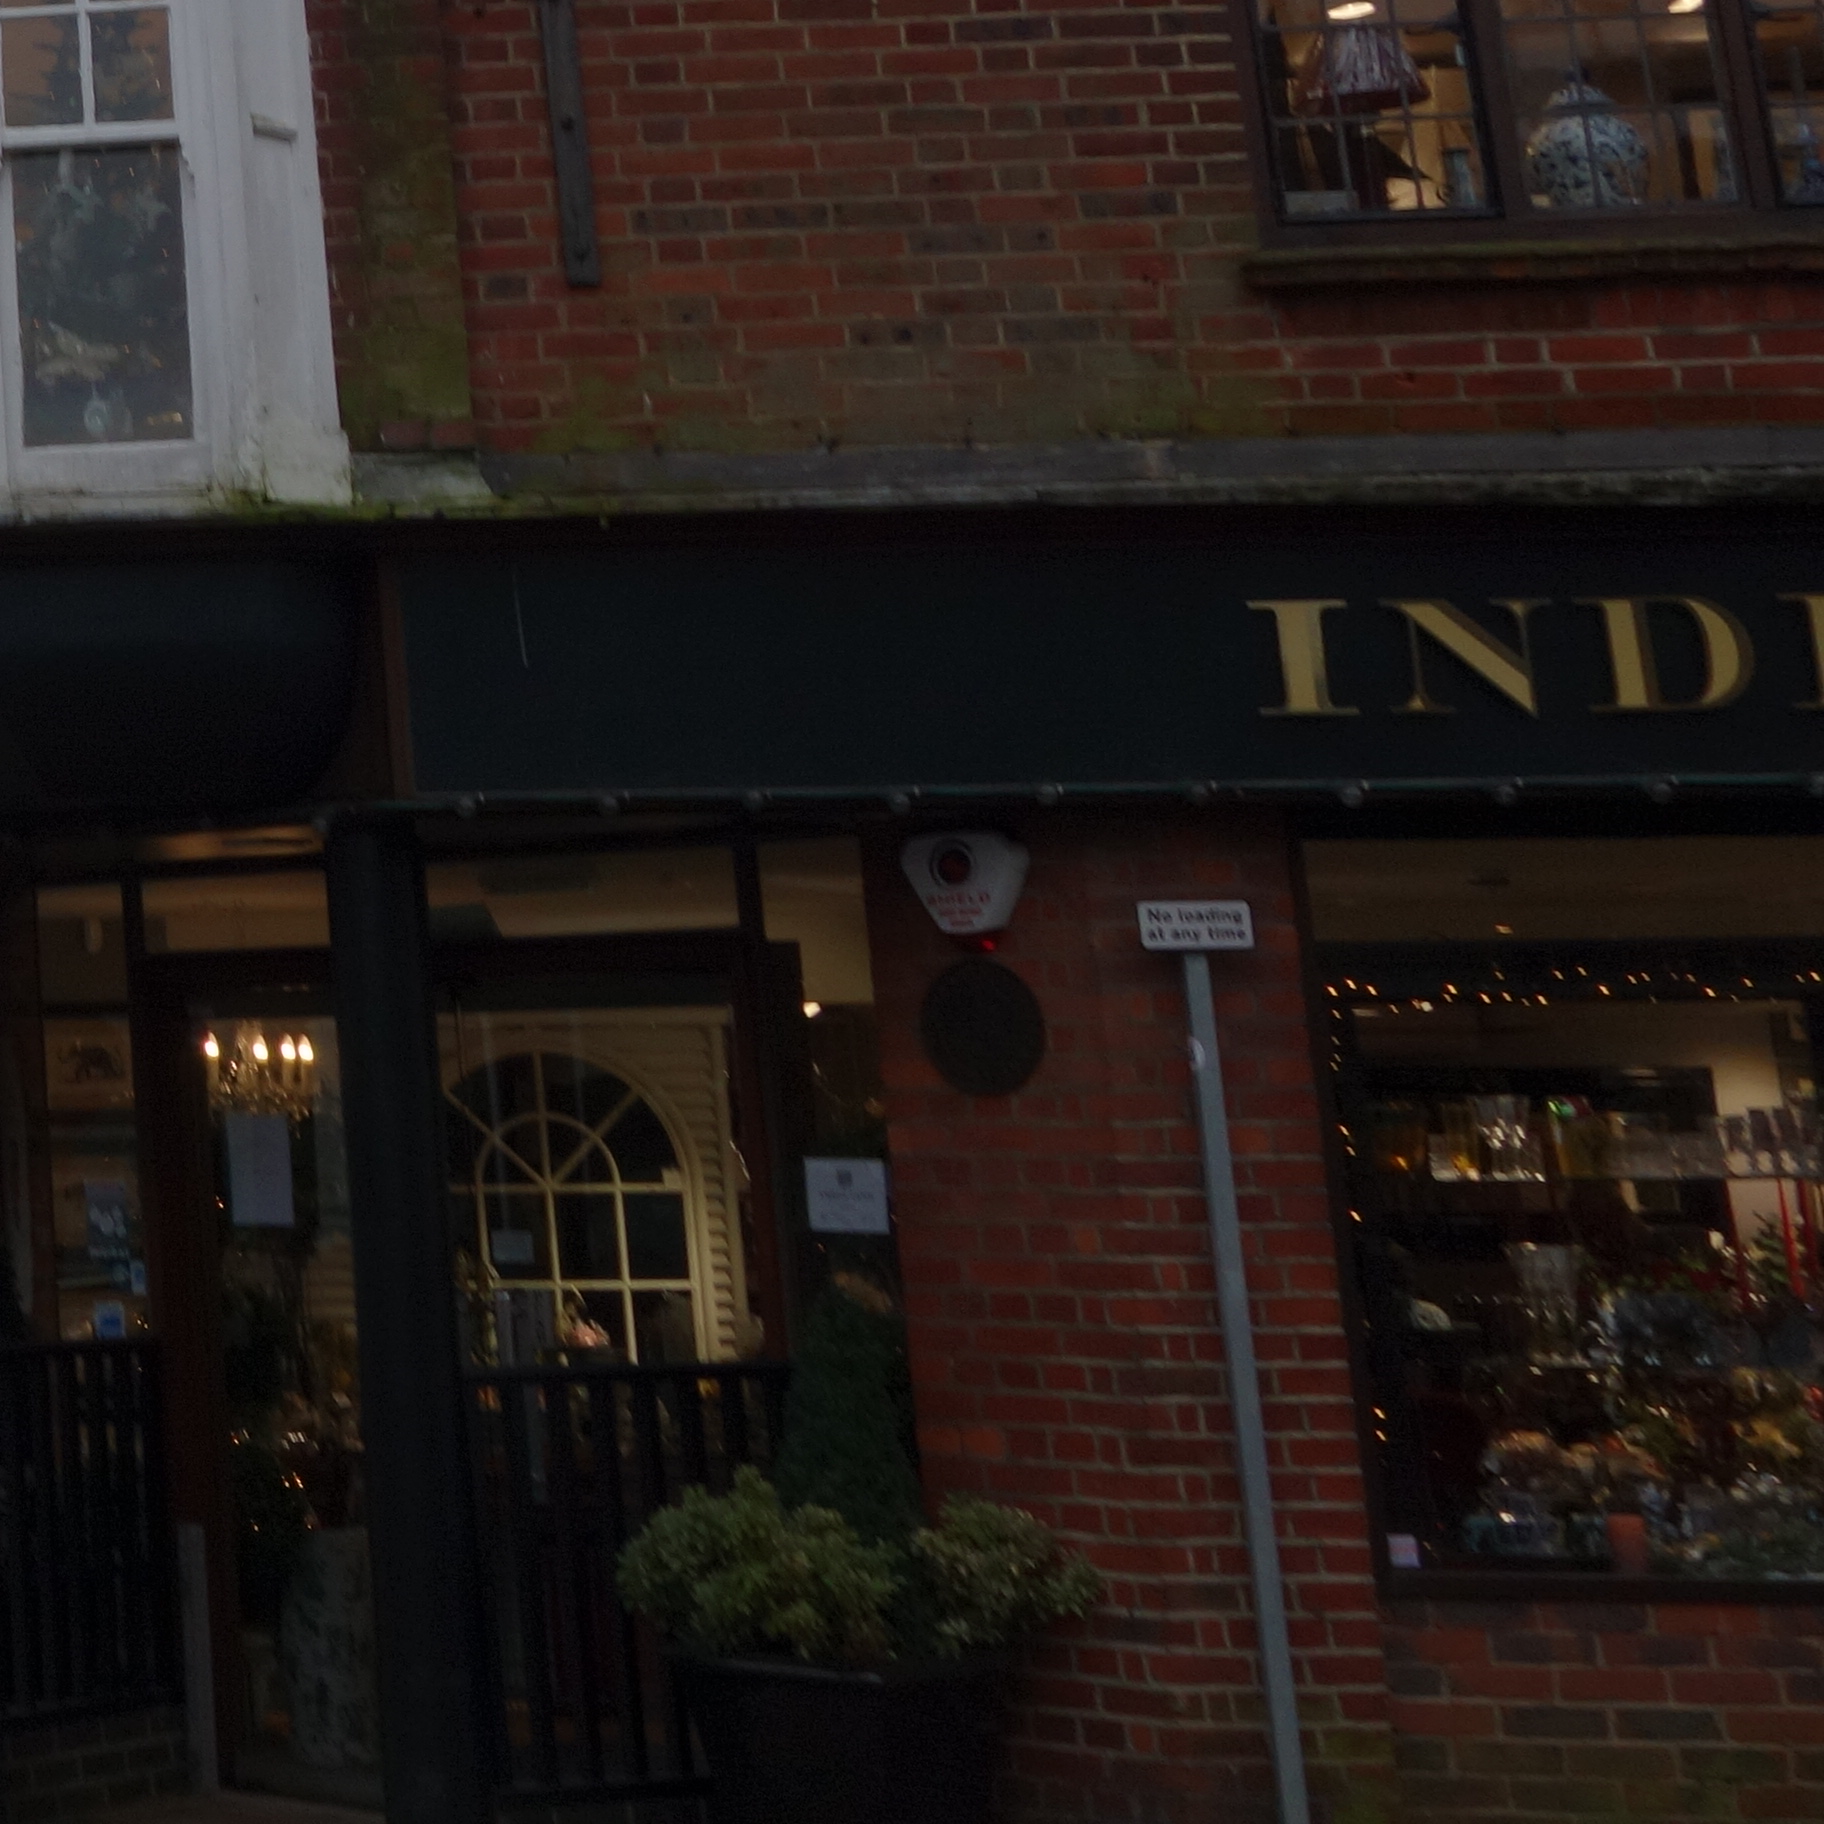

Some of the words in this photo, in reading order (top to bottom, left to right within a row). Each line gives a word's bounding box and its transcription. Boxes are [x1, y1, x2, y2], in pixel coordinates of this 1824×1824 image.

[1148, 907, 1172, 924] No
[1177, 907, 1243, 925] loading
[1149, 925, 1166, 941] at
[1172, 928, 1200, 943] any
[1207, 924, 1246, 941] time
